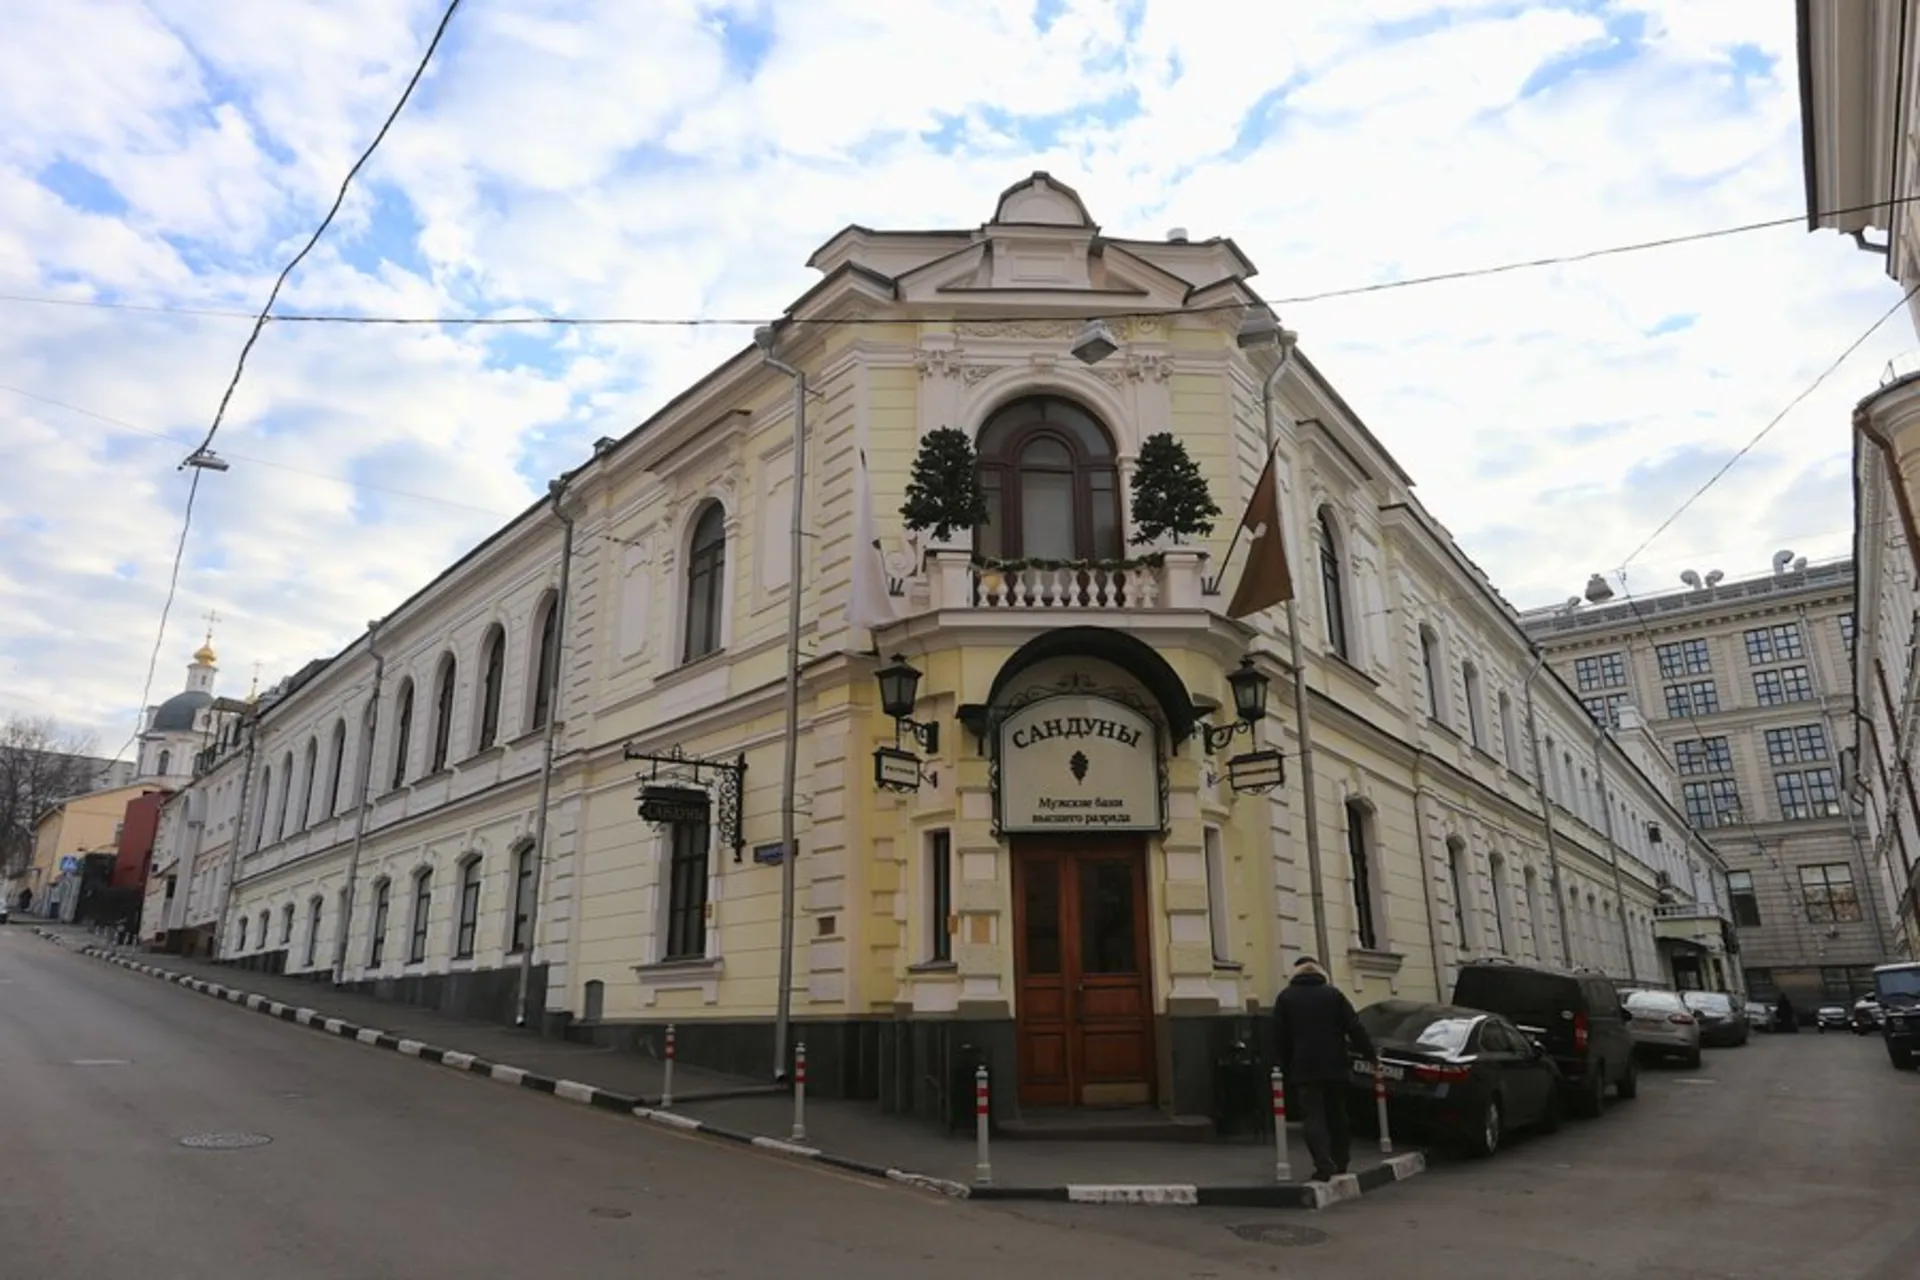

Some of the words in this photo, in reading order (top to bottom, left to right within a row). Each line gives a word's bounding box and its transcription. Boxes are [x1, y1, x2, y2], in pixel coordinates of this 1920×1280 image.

[1012, 717, 1142, 749] САНДУНЫ
[1038, 797, 1092, 810] Мужские
[1095, 796, 1123, 808] бани
[1032, 813, 1084, 823] высшего
[1085, 813, 1132, 825] разряда
